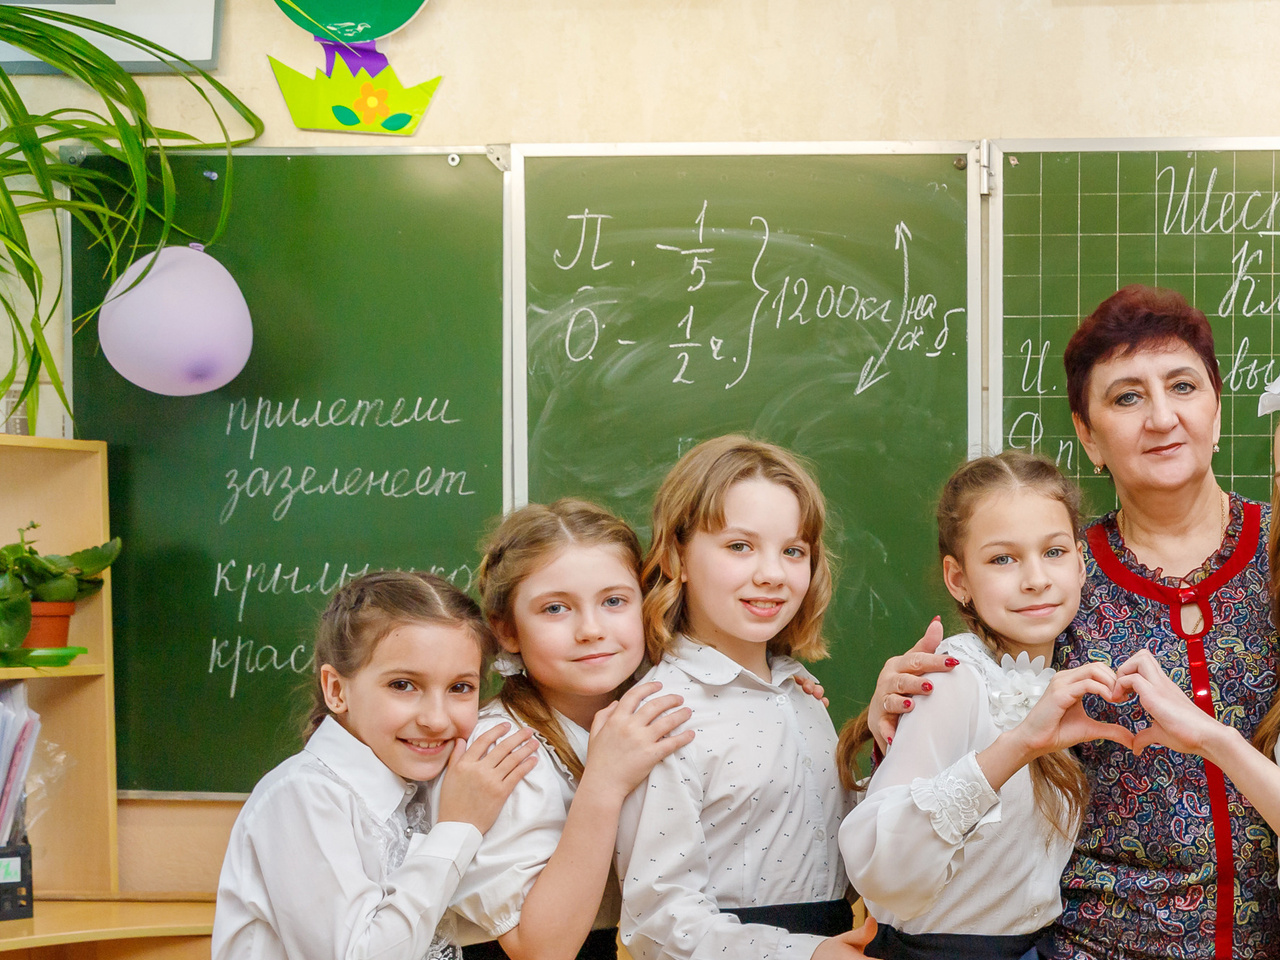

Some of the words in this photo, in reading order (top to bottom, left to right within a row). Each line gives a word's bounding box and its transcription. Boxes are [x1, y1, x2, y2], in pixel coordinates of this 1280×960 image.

[905, 293, 937, 325] на
[226, 397, 461, 460] прилетели
[219, 466, 475, 525] зазеленеет
